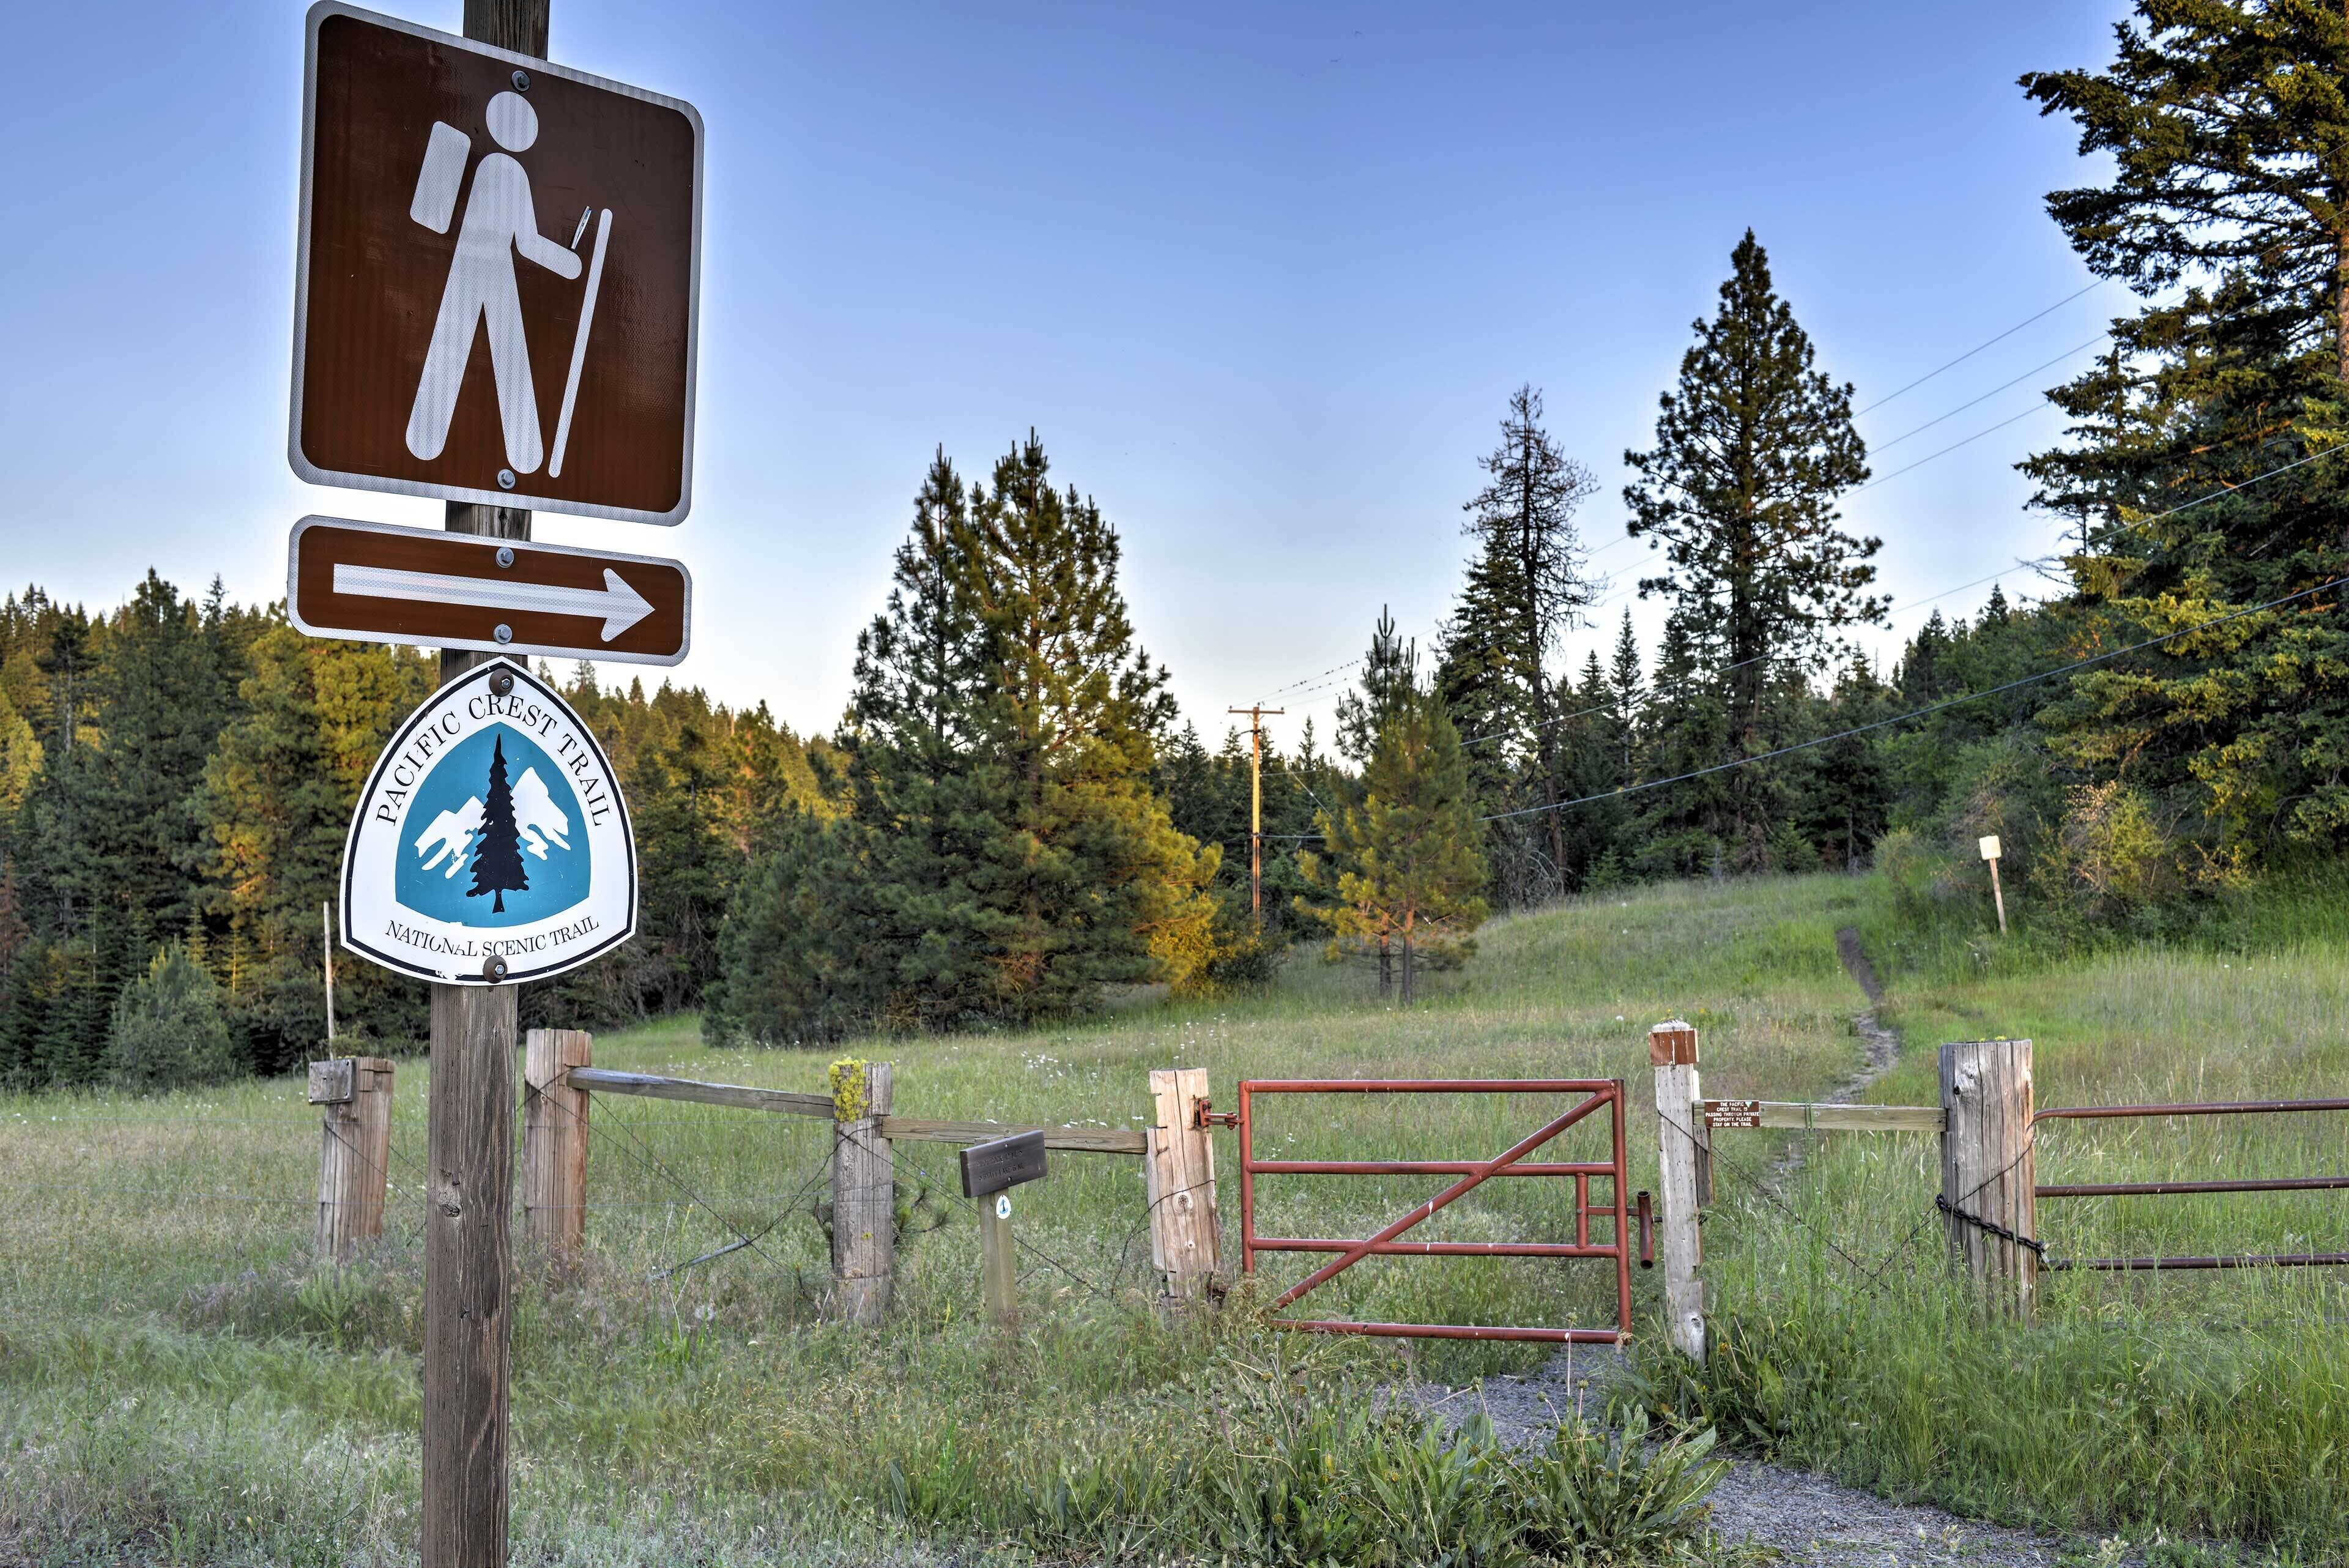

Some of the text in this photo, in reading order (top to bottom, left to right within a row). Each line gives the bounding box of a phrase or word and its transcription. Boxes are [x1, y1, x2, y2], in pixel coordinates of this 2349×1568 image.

[376, 694, 610, 827] PACIFIC CREST TRAIL
[385, 915, 599, 957] NATIONAL SCENIC TRAIL
